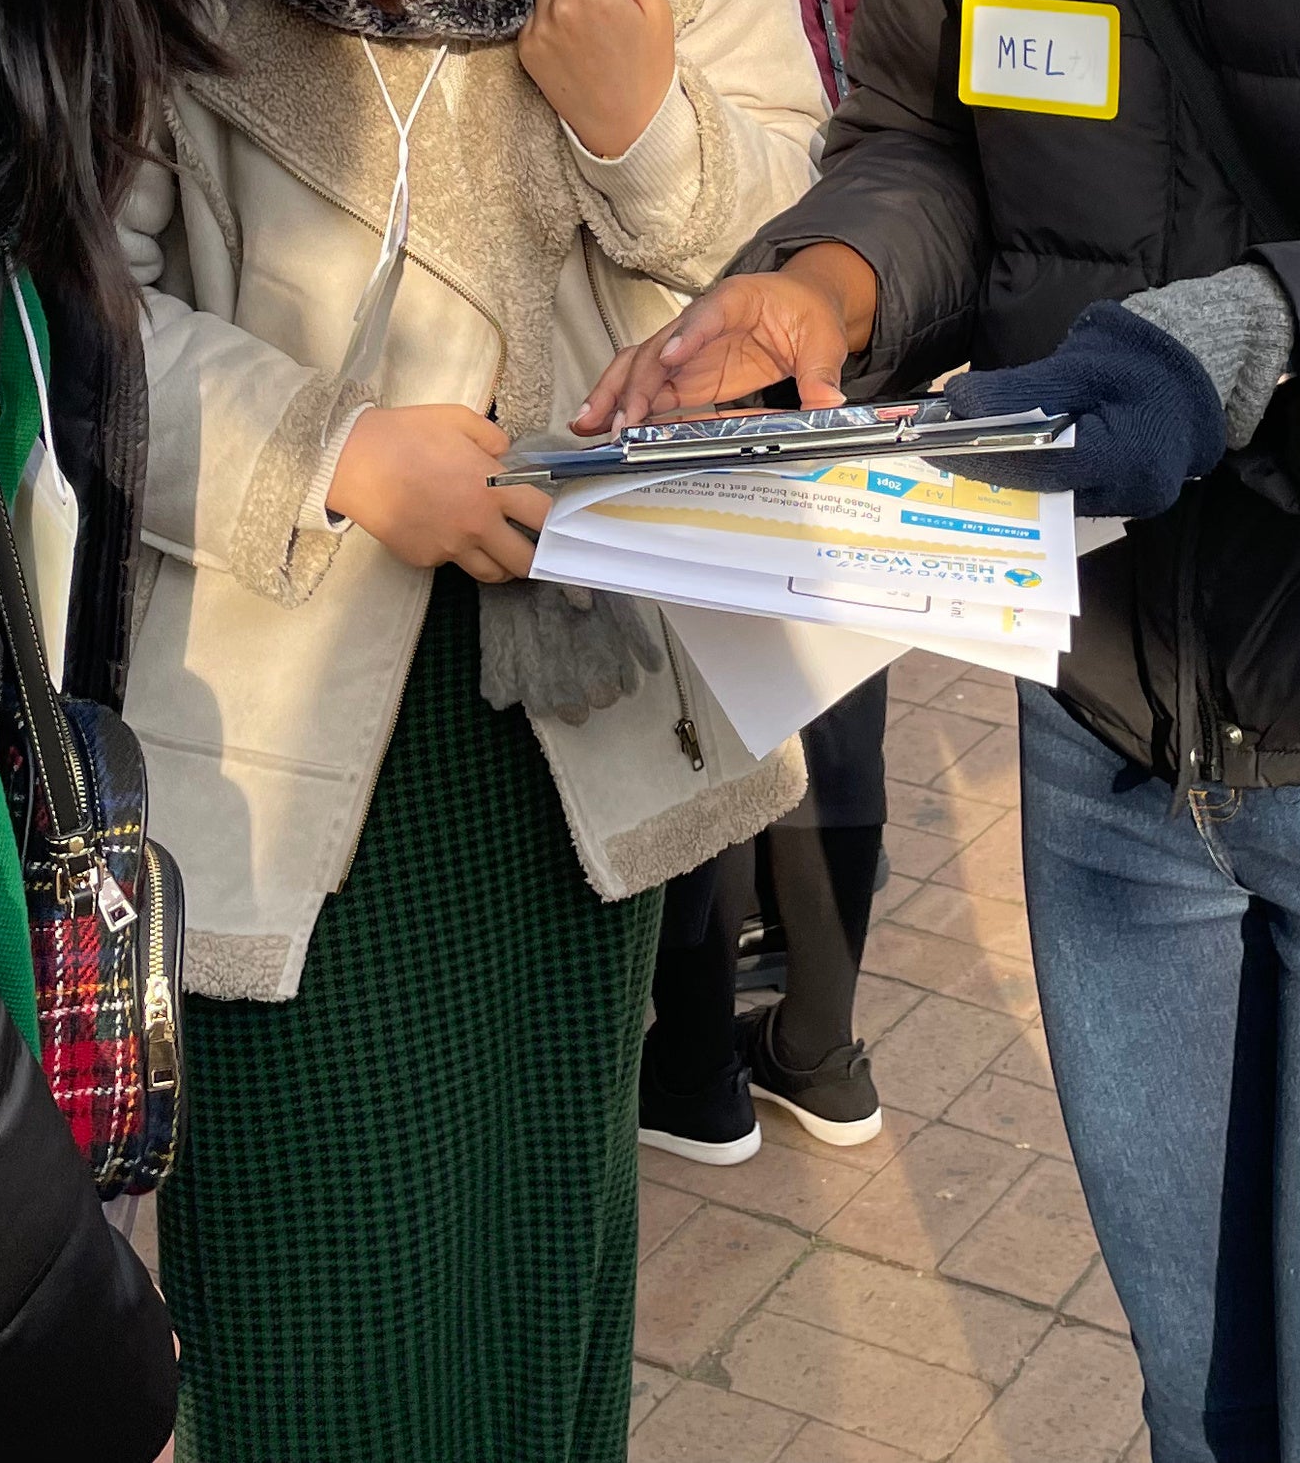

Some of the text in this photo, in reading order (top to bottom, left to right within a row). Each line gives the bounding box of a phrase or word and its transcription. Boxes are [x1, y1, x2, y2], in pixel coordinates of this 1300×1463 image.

[998, 35, 1065, 76] MEL
[713, 482, 726, 490] to
[877, 477, 902, 491] 20pt
[654, 486, 715, 498] encourage
[718, 491, 755, 502] please
[751, 485, 787, 499] binder
[791, 490, 809, 500] the
[813, 493, 841, 504] hand
[816, 504, 857, 518] English
[844, 498, 881, 513] Please
[860, 512, 880, 523] For
[817, 548, 912, 568] WORLD!
[922, 559, 994, 575] HELLO
